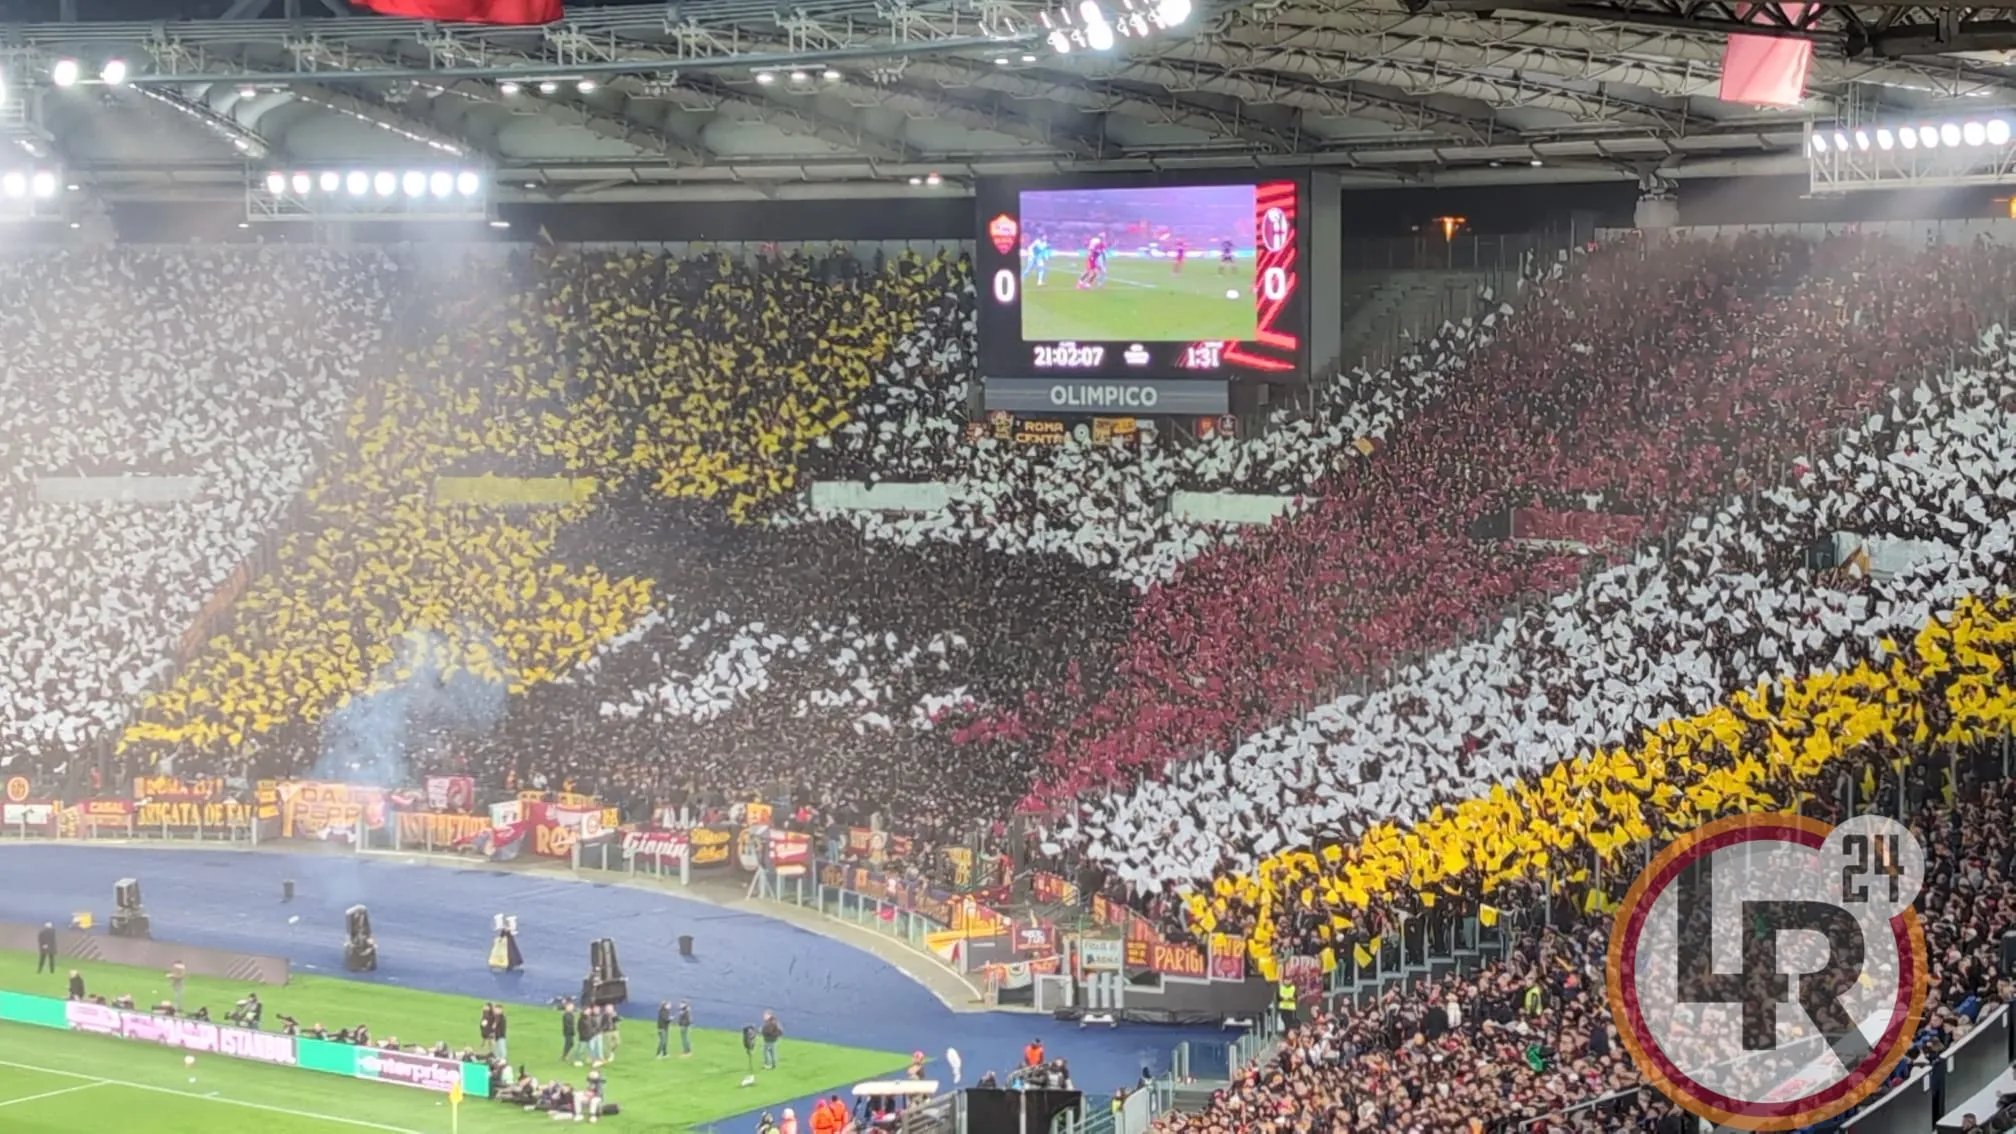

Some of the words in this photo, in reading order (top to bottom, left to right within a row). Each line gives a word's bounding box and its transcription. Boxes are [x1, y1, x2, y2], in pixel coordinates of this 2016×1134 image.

[995, 269, 1015, 302] 0
[1265, 267, 1286, 300] 0
[1034, 346, 1105, 367] 21:02:07
[1187, 347, 1220, 367] 1:31
[1050, 385, 1158, 406] OLIMPICO
[1024, 421, 1064, 432] ROMA
[220, 1027, 297, 1065] ISTANBUL
